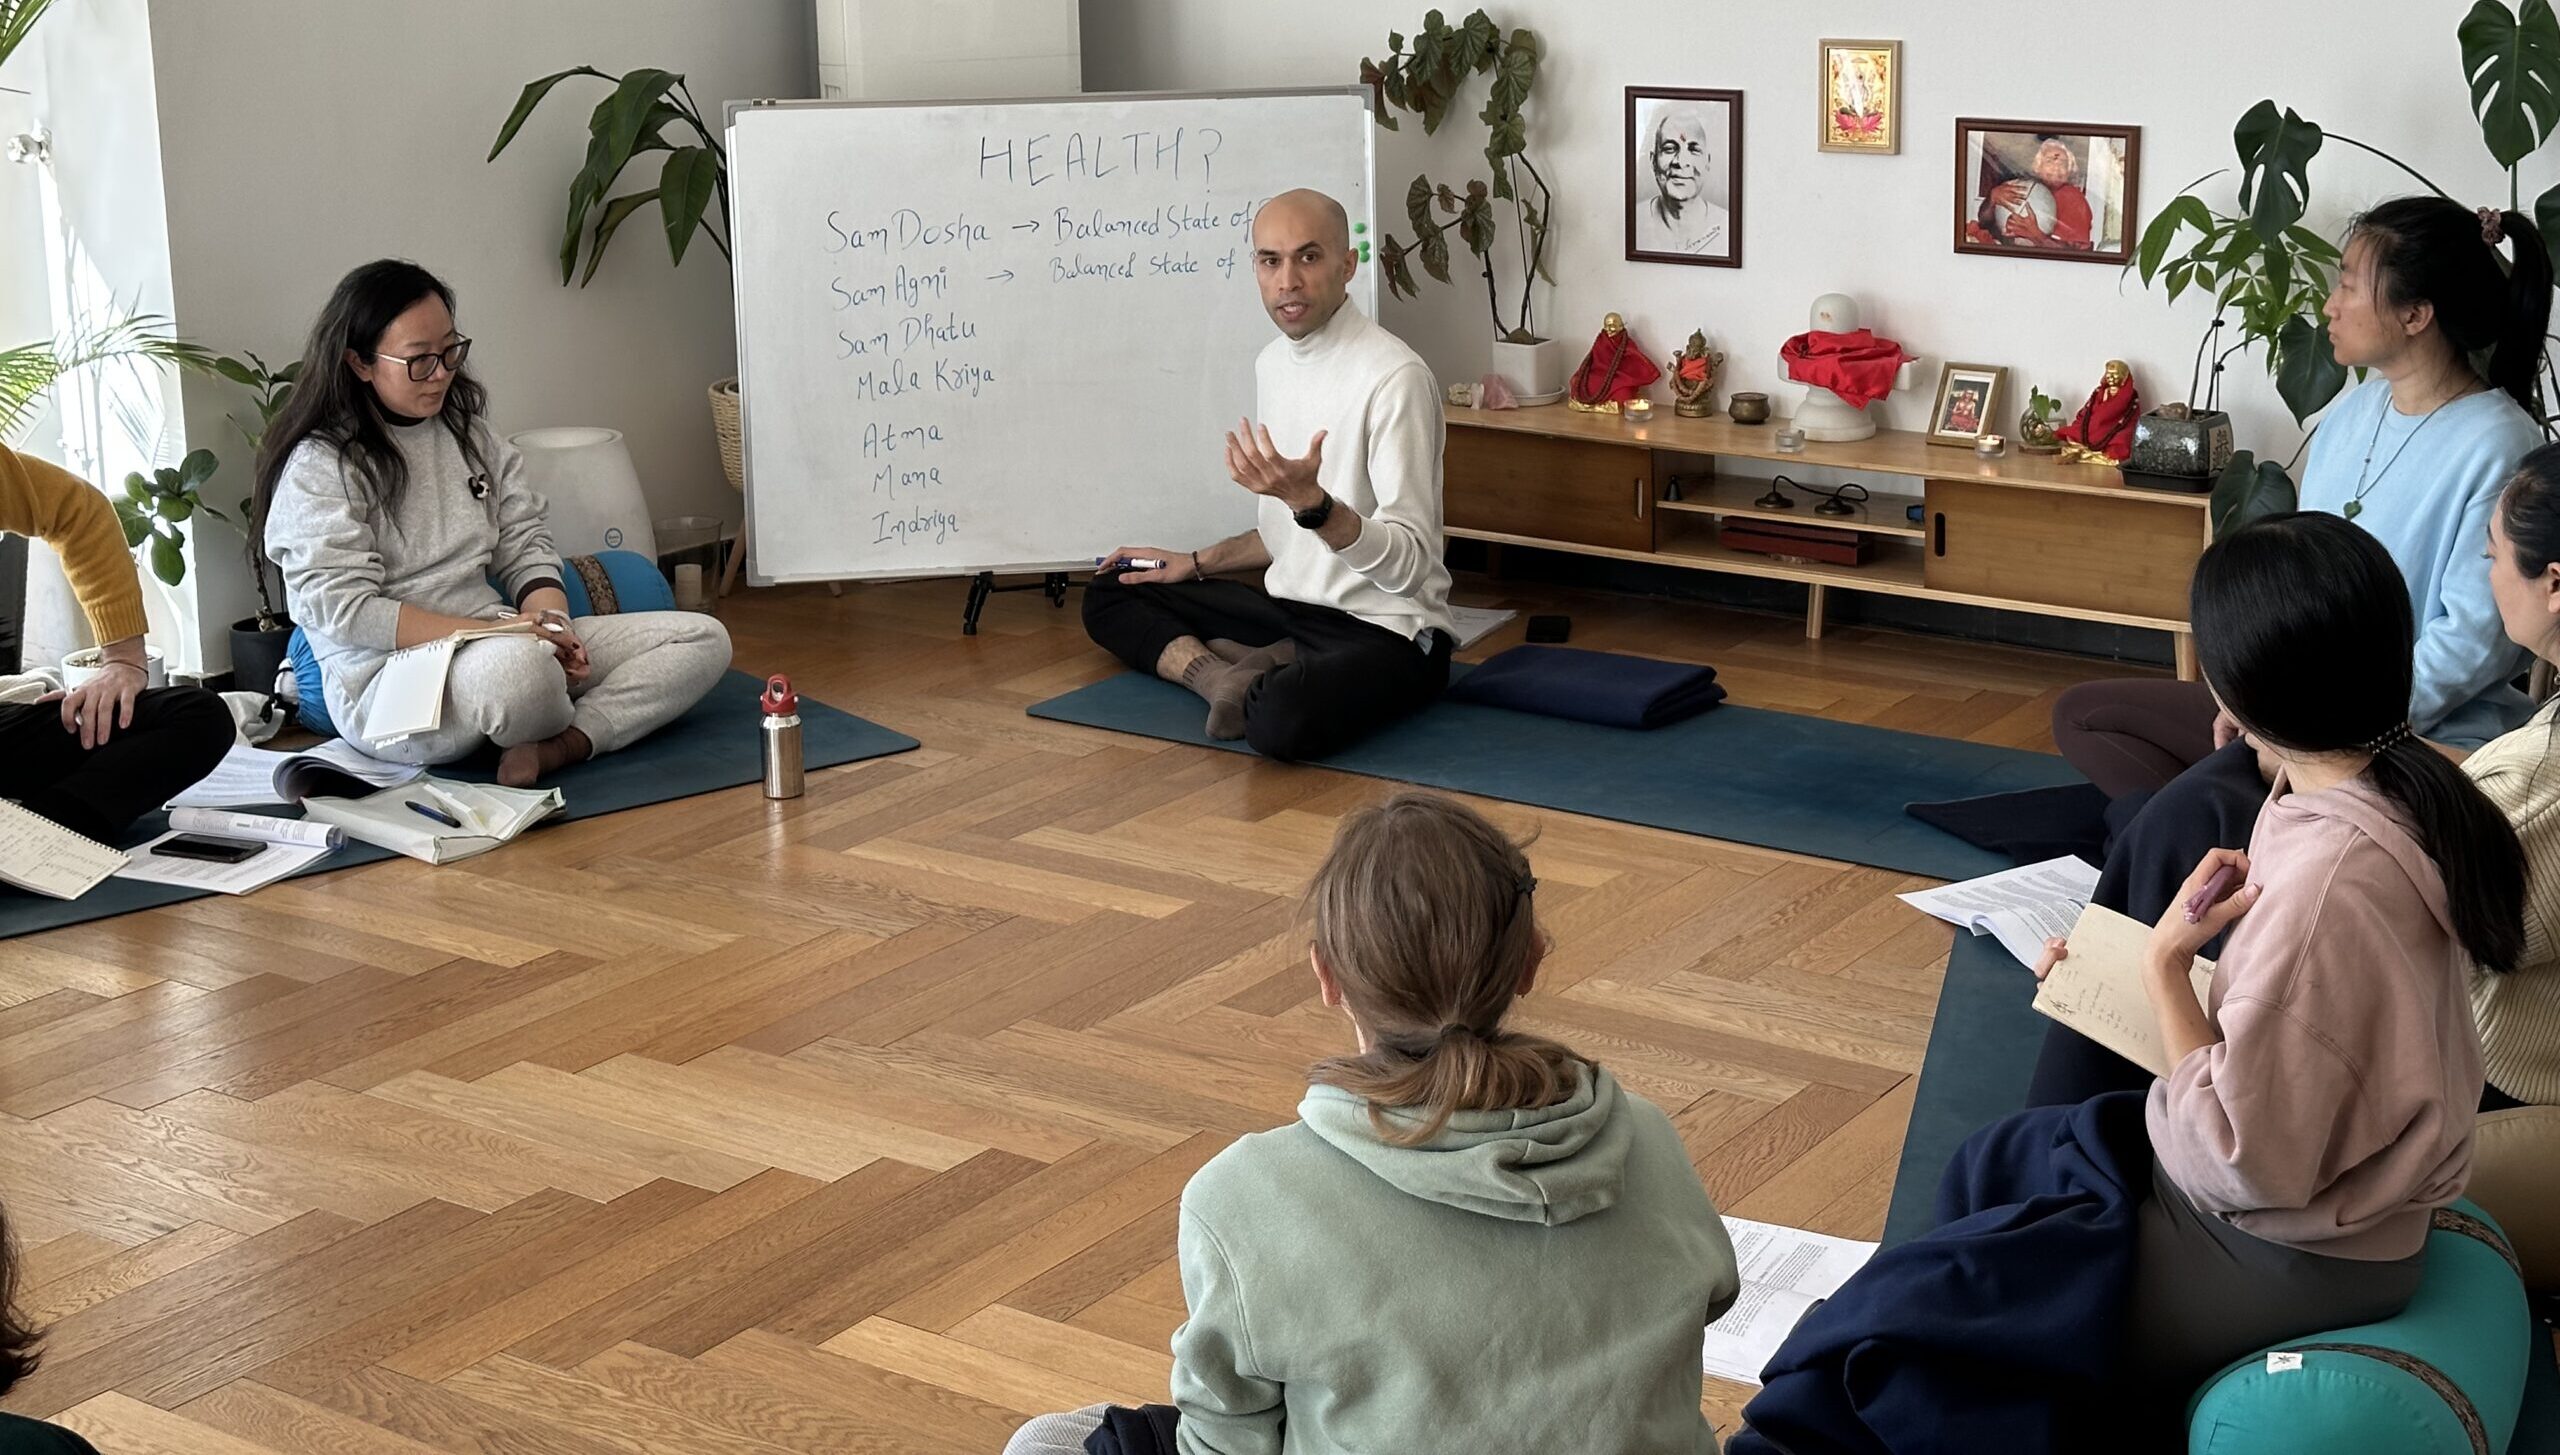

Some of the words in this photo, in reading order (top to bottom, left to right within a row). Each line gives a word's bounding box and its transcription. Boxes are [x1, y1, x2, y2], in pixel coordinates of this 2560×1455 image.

[980, 127, 1222, 193] HEALTH?
[823, 210, 888, 255] Sam
[891, 208, 991, 251] Dosha
[1053, 206, 1160, 247] Balanced
[1166, 202, 1221, 240] State
[1230, 200, 1253, 244] of
[831, 276, 885, 312] Sam
[895, 264, 948, 308] Agni
[1049, 251, 1137, 284] Balanced
[1216, 247, 1236, 280] of
[837, 329, 889, 361] Sam
[898, 311, 977, 352] Dhatu
[857, 358, 921, 401] Mala
[935, 358, 995, 398] Kriya
[863, 422, 944, 459] Atma
[873, 463, 942, 501] Mana
[872, 505, 960, 546] Indriya
